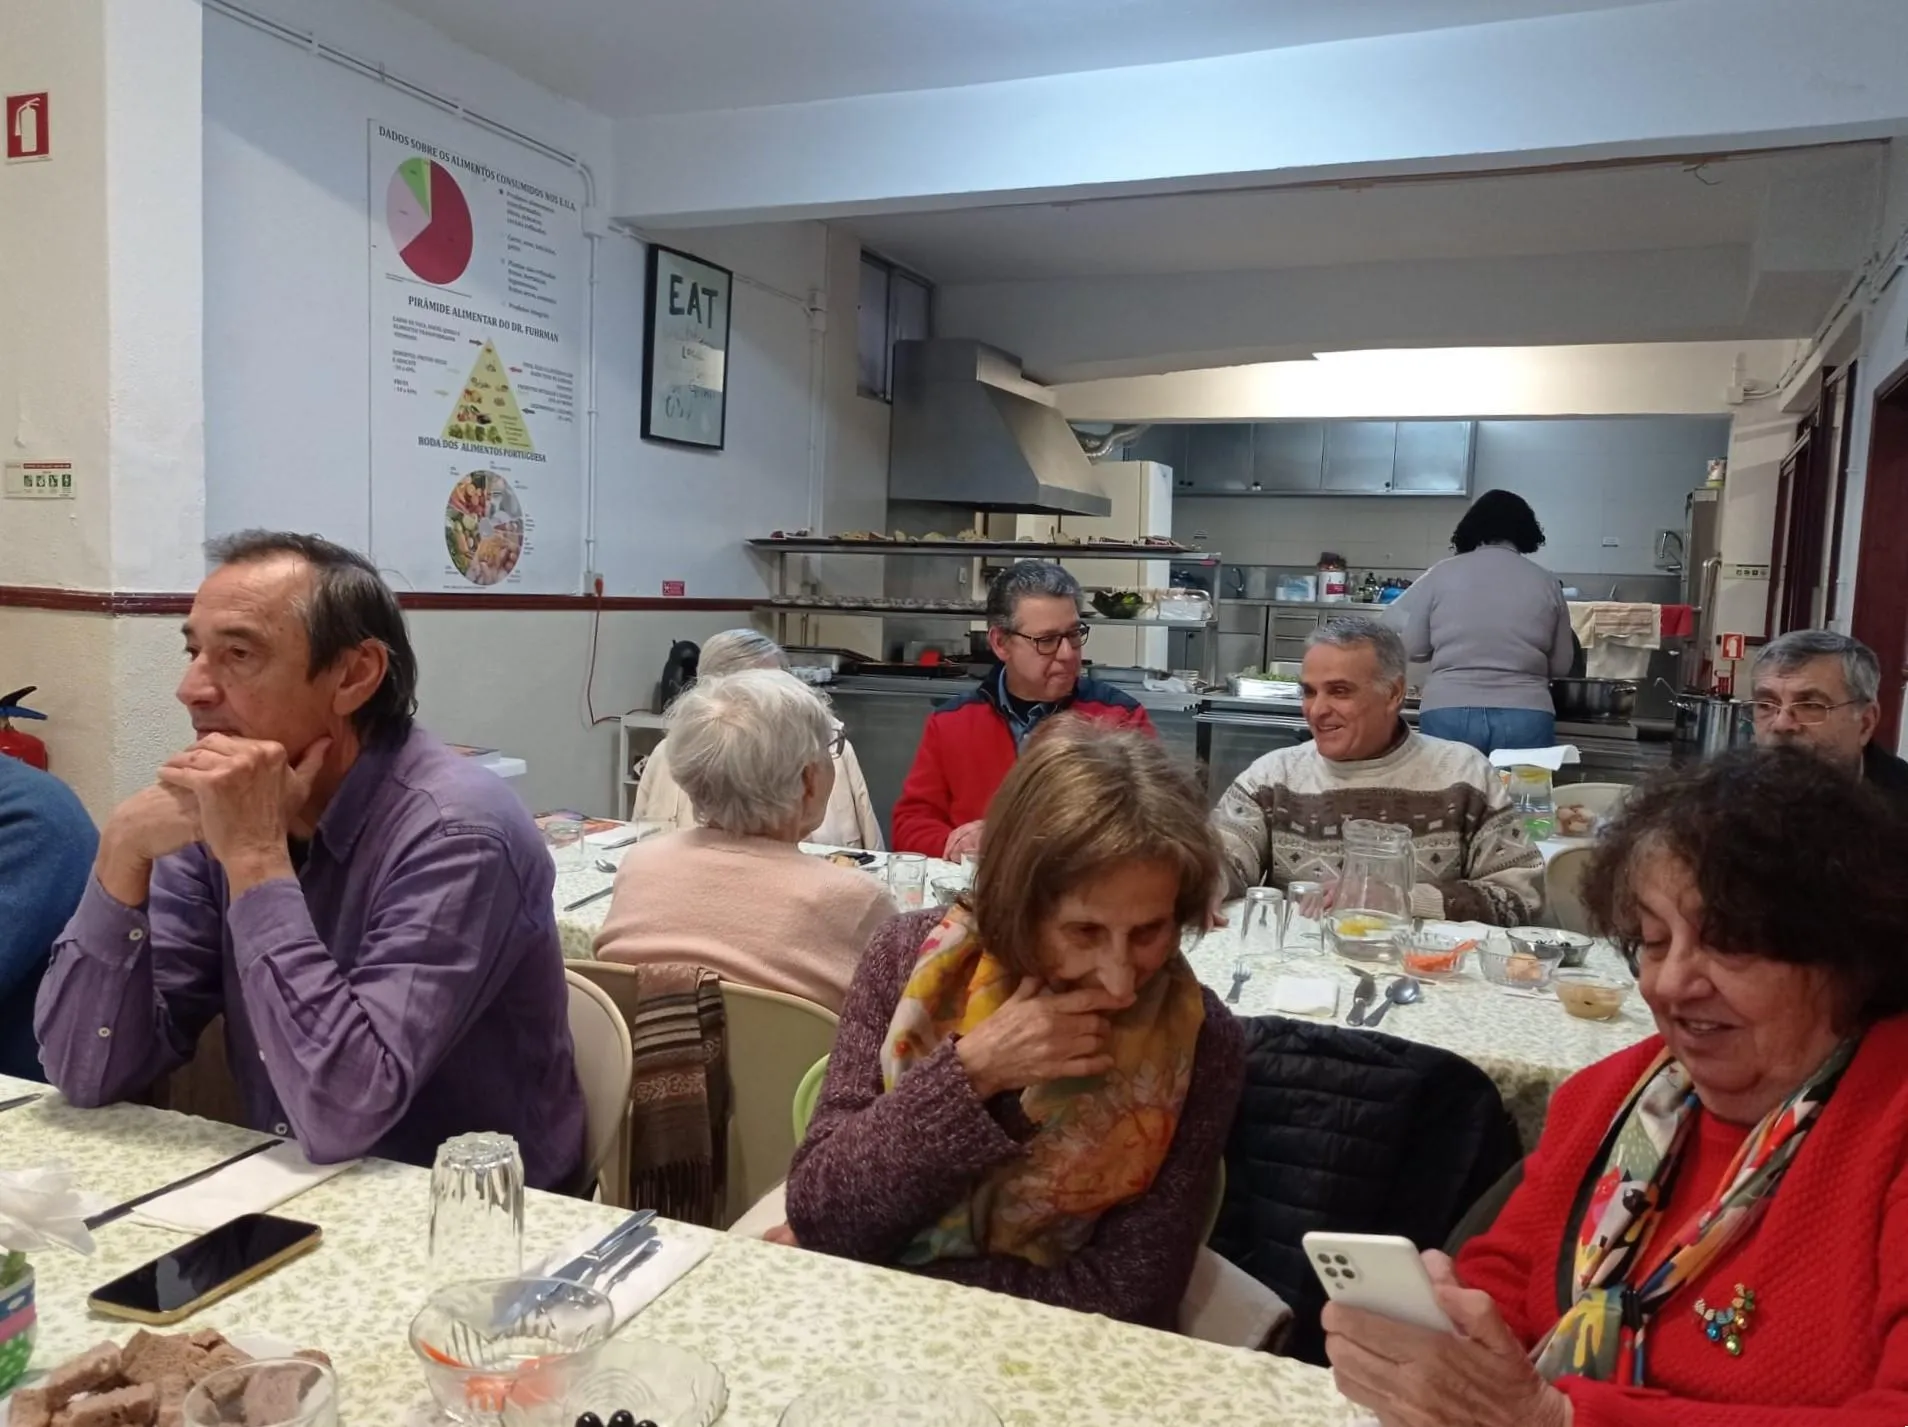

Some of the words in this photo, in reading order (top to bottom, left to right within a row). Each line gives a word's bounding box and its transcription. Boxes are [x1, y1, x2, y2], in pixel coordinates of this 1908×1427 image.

[379, 126, 409, 146] DADOS
[410, 138, 438, 158] SOBRE
[439, 150, 450, 162] OS
[451, 156, 495, 180] ALIMENTOS
[496, 173, 544, 200] CONSUMIDOS
[408, 295, 451, 315] PIRÂMIDE
[452, 307, 498, 328] ALIMENTAR
[499, 319, 510, 330] DO
[511, 324, 524, 334] DR.
[525, 326, 559, 343] FUHRMAN
[669, 273, 719, 329] EAT
[418, 436, 443, 449] RODA
[443, 439, 458, 450] DOS
[461, 442, 502, 457] ALIMENTOS
[503, 447, 547, 463] PORTUGUESA
